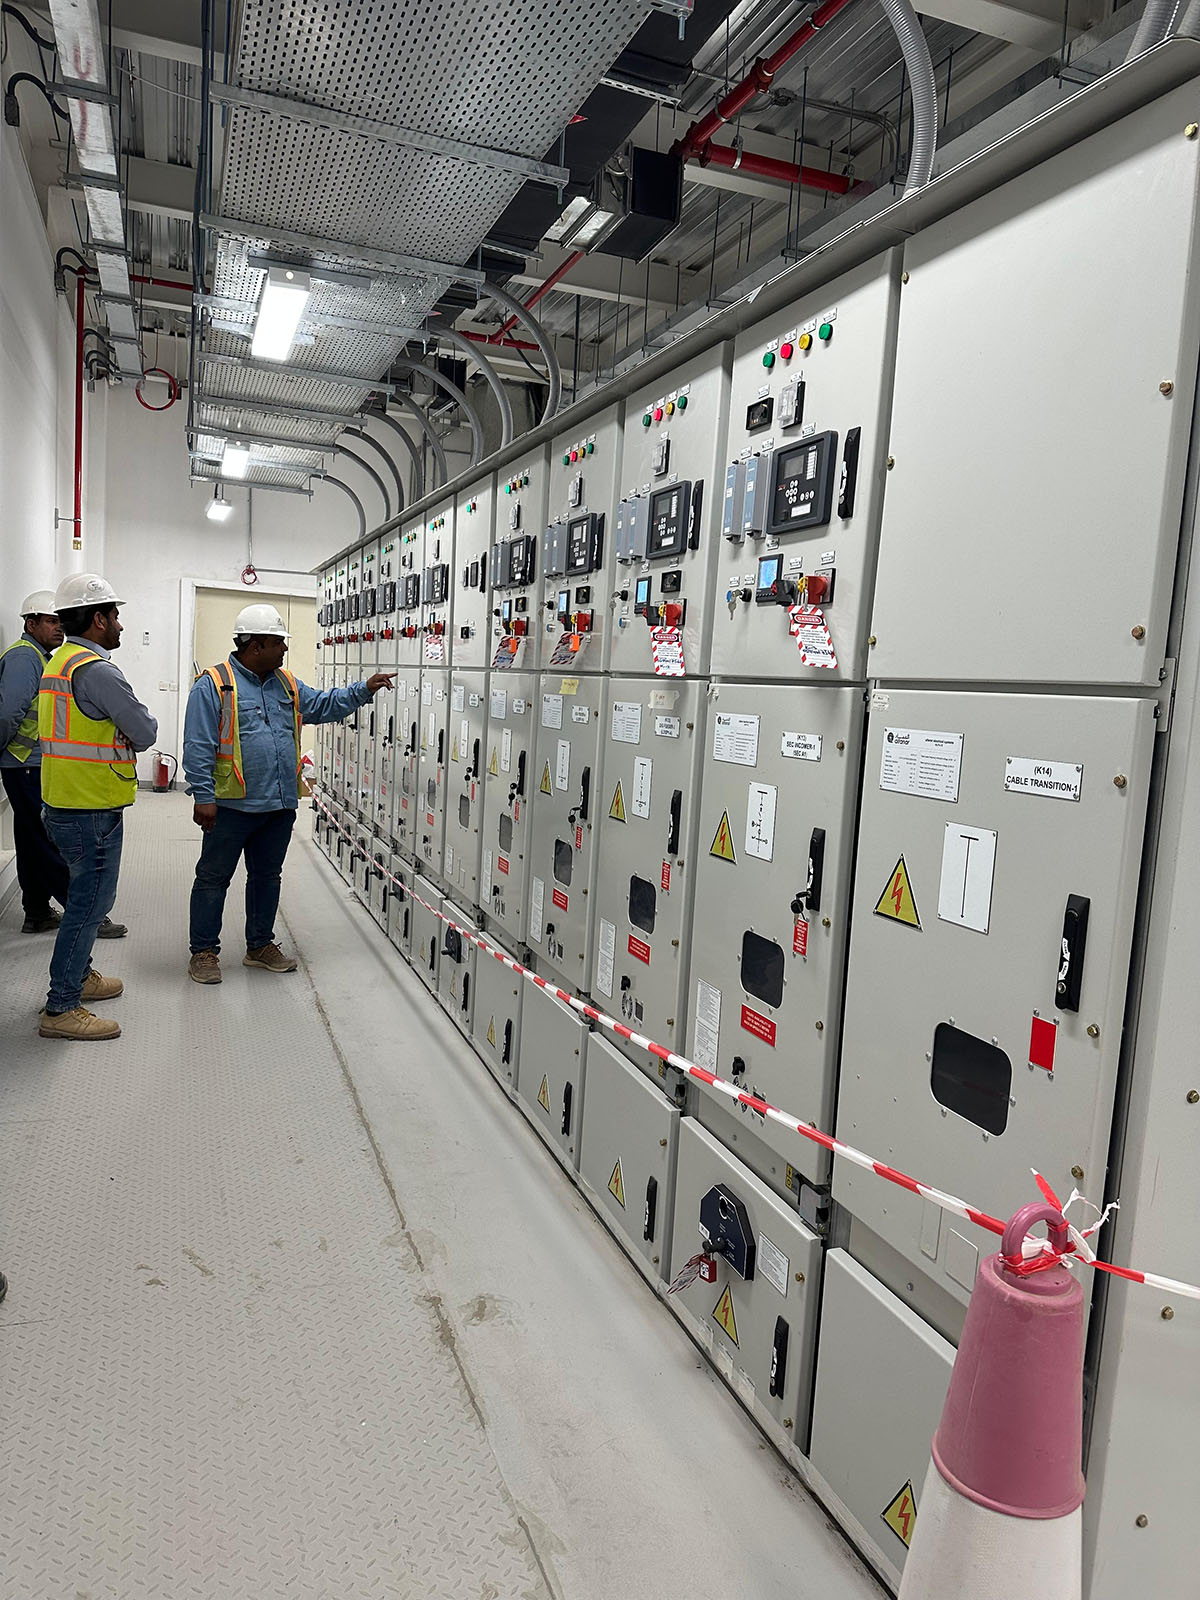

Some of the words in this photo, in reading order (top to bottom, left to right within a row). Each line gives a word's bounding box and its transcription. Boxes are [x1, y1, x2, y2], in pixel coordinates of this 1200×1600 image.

[1034, 766, 1053, 778] (K14)
[1006, 775, 1029, 786] CABLE
[1030, 778, 1078, 792] TRANSITION-1
